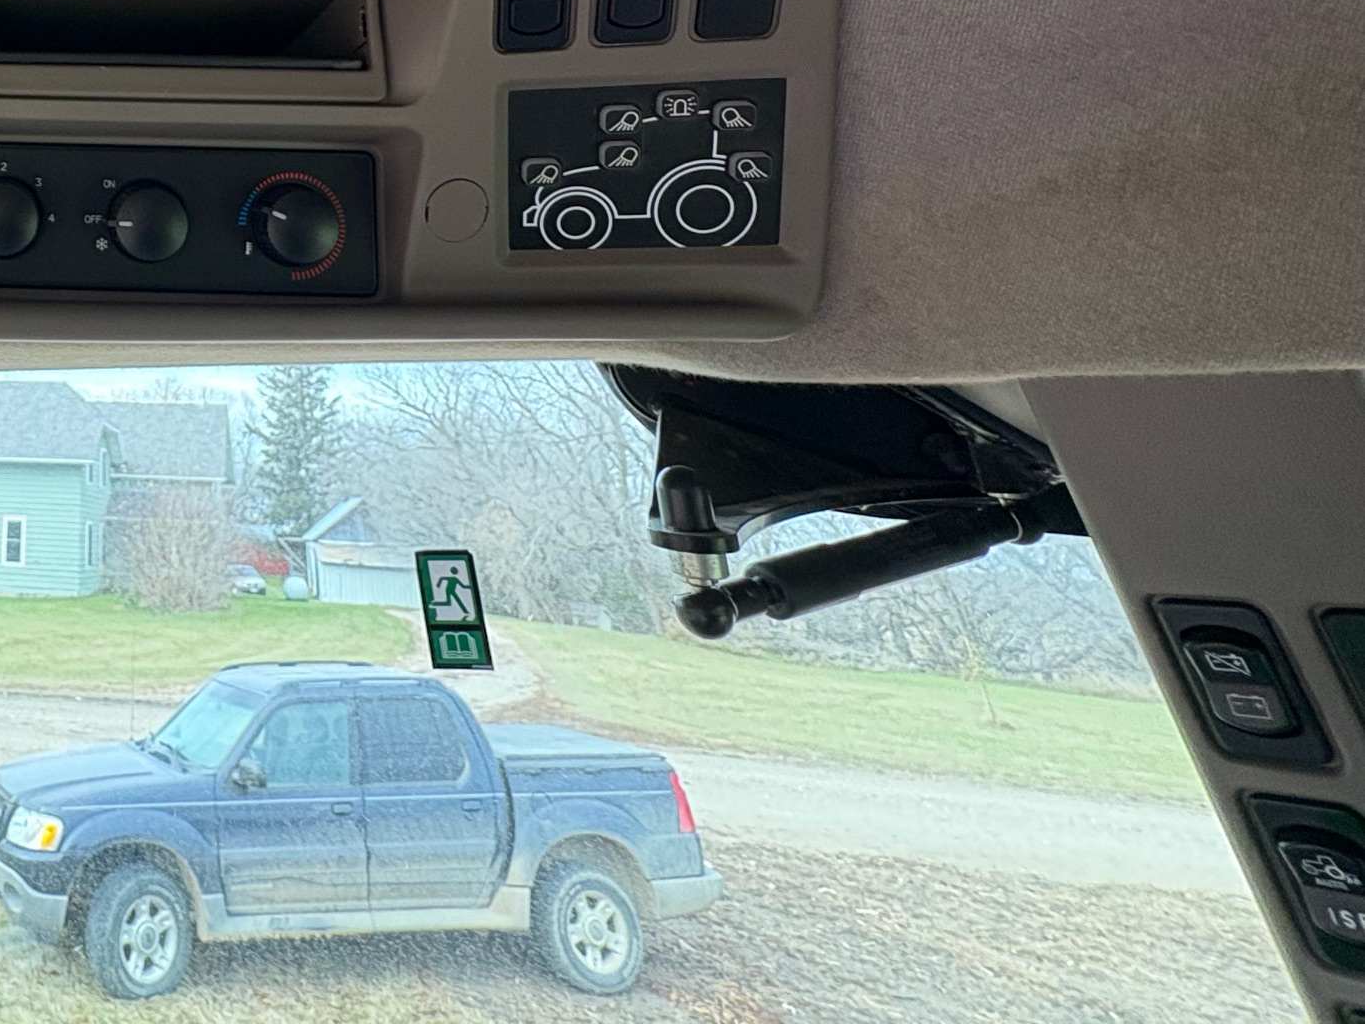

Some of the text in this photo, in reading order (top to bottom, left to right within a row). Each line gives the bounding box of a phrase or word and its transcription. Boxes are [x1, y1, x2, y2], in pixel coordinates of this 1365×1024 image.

[0, 162, 8, 172] 2
[35, 177, 43, 187] 3
[103, 179, 116, 188] ON
[47, 214, 56, 223] 4
[84, 214, 102, 224] OFF
